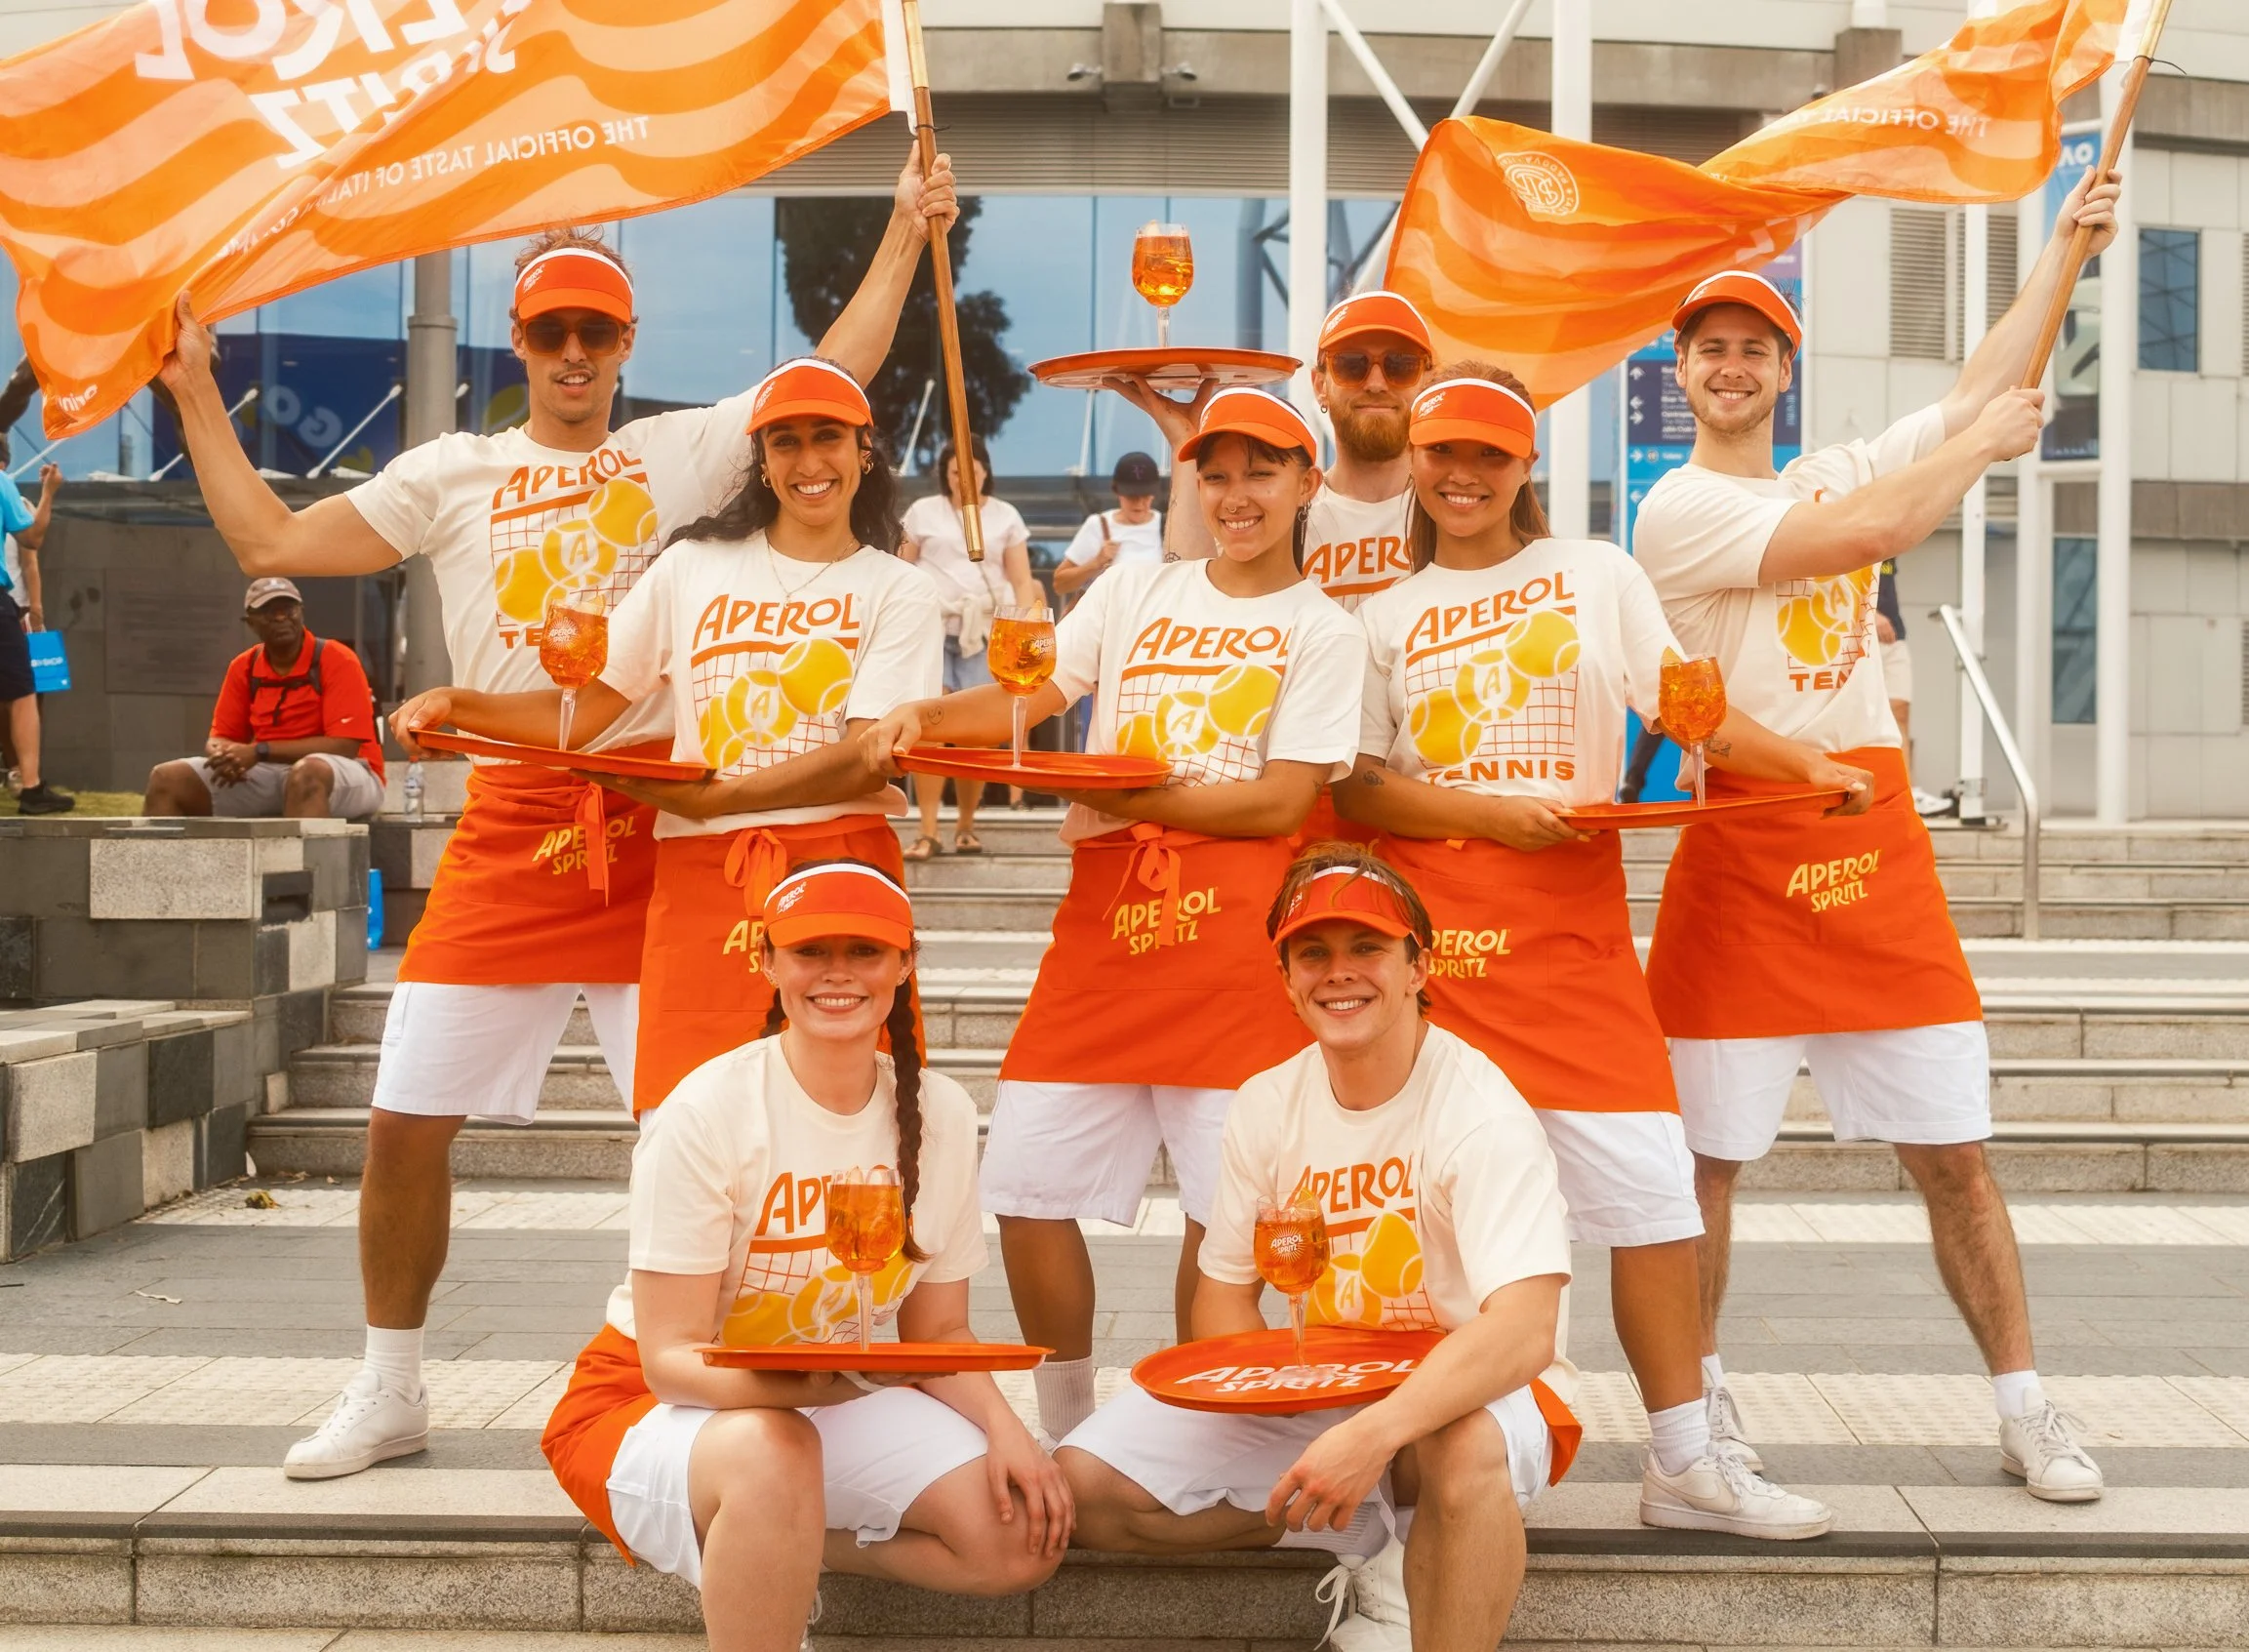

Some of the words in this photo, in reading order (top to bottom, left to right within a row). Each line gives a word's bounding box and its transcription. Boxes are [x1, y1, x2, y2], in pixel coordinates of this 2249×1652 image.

[492, 448, 642, 510] APEROL
[1303, 536, 1412, 584] APER
[692, 592, 861, 651] APEROL
[1406, 571, 1575, 654] APEROL
[1126, 617, 1293, 665] APEROL
[532, 816, 637, 863] APEOL
[1786, 849, 1880, 898] APEROL
[1811, 879, 1868, 913] SPRITZ
[1129, 919, 1198, 955] SPTZ
[1430, 928, 1511, 956] PEROL
[1428, 957, 1487, 979] SPRITZ
[1284, 1154, 1414, 1213] APEROL
[1270, 1233, 1304, 1250] APEROL
[1277, 1244, 1298, 1254] SPRITZ
